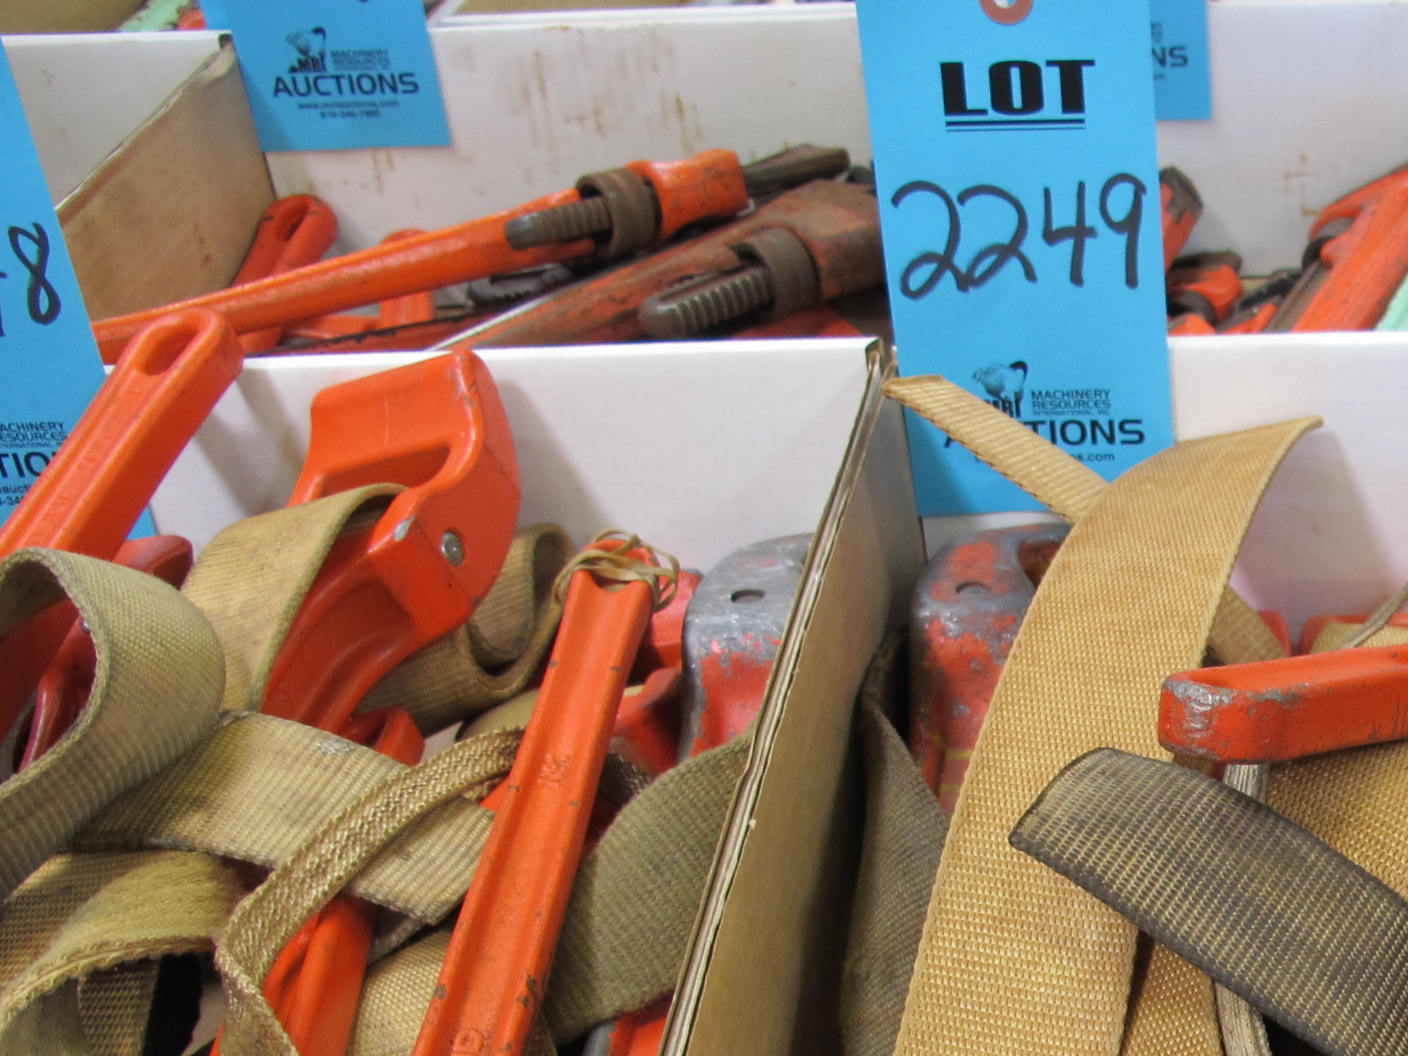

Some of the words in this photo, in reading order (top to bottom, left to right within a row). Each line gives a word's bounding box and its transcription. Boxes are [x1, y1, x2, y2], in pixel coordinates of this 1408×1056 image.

[273, 72, 420, 98] AUCTIONS
[940, 59, 1095, 117] LOT
[891, 172, 1147, 299] 2249
[0, 222, 61, 337] 8
[1031, 389, 1111, 401] MACHINERY
[1032, 399, 1111, 410] RESOURCES
[0, 421, 64, 432] ACHINERY
[0, 431, 67, 442] ESOURCES
